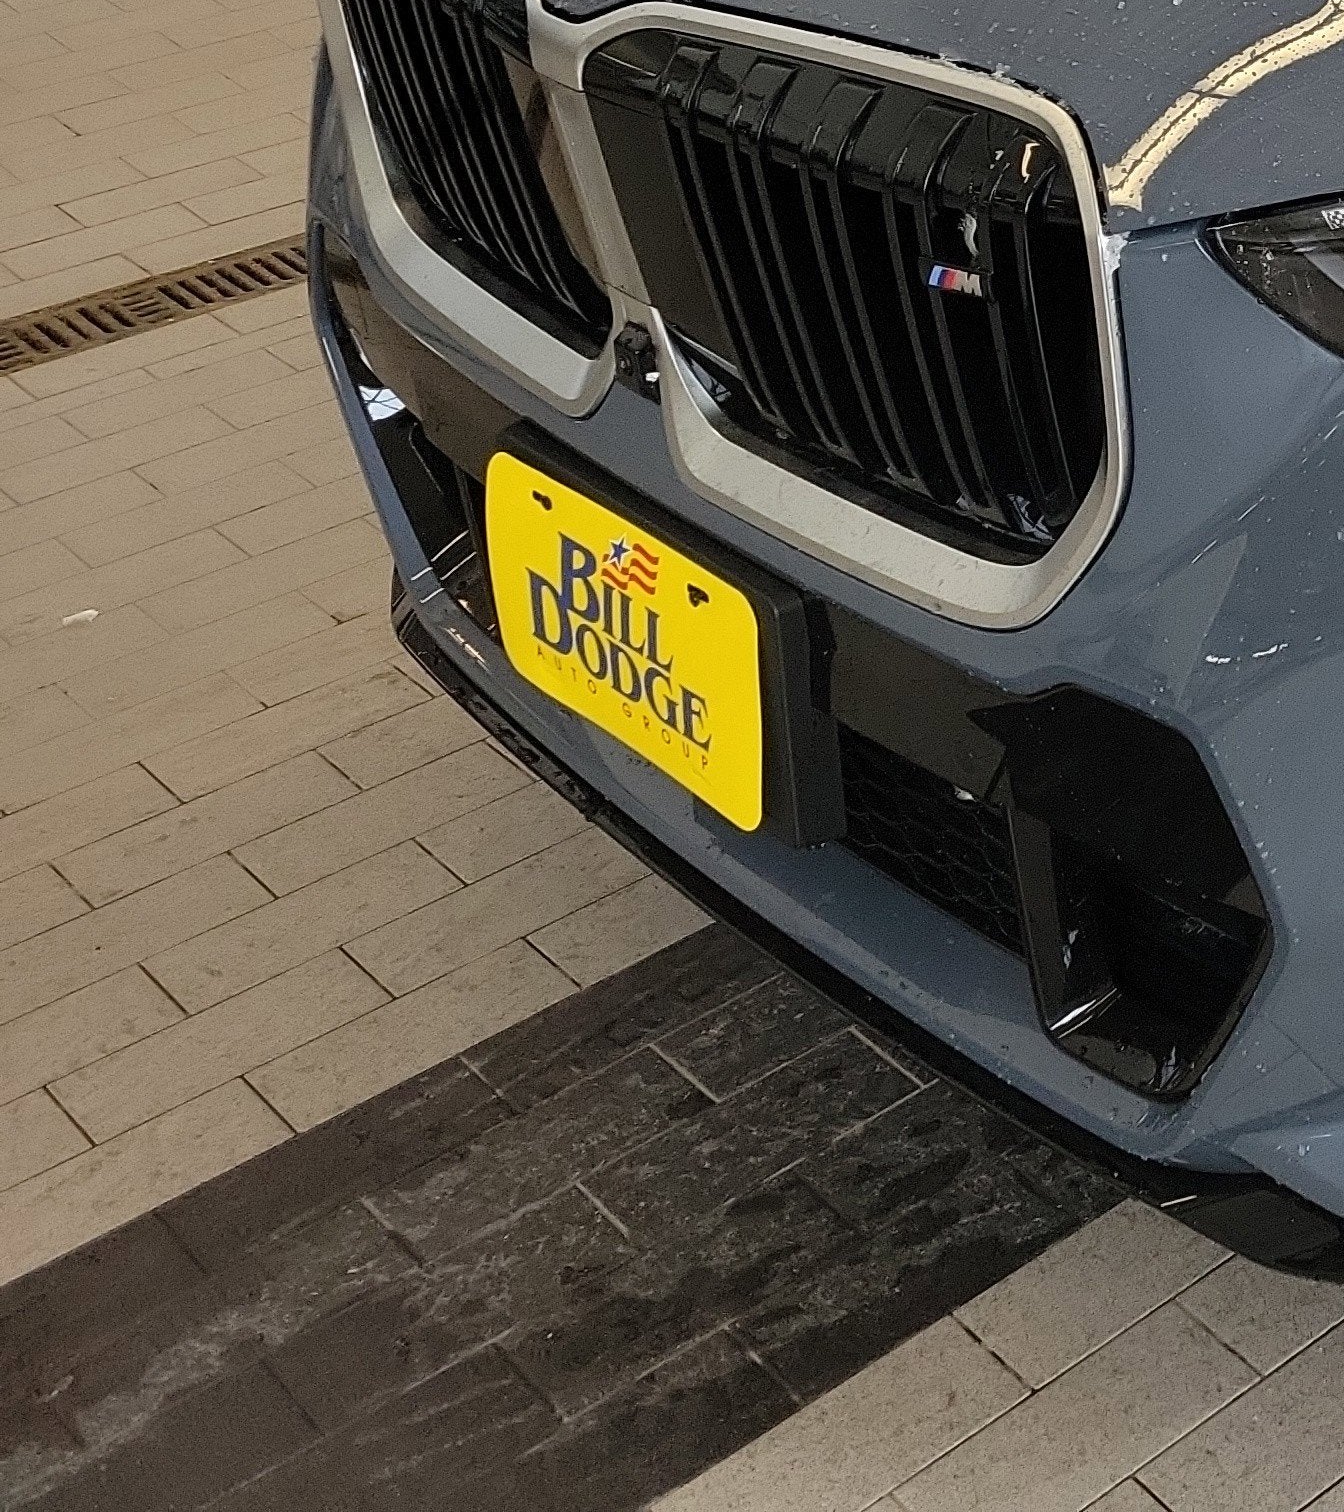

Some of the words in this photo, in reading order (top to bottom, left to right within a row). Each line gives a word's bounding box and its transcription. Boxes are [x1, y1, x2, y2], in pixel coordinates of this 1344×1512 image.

[953, 269, 983, 297] M
[525, 567, 712, 752] DODGE
[558, 531, 675, 672] BILL
[536, 645, 598, 696] AUTO
[621, 702, 710, 771] GROUP
